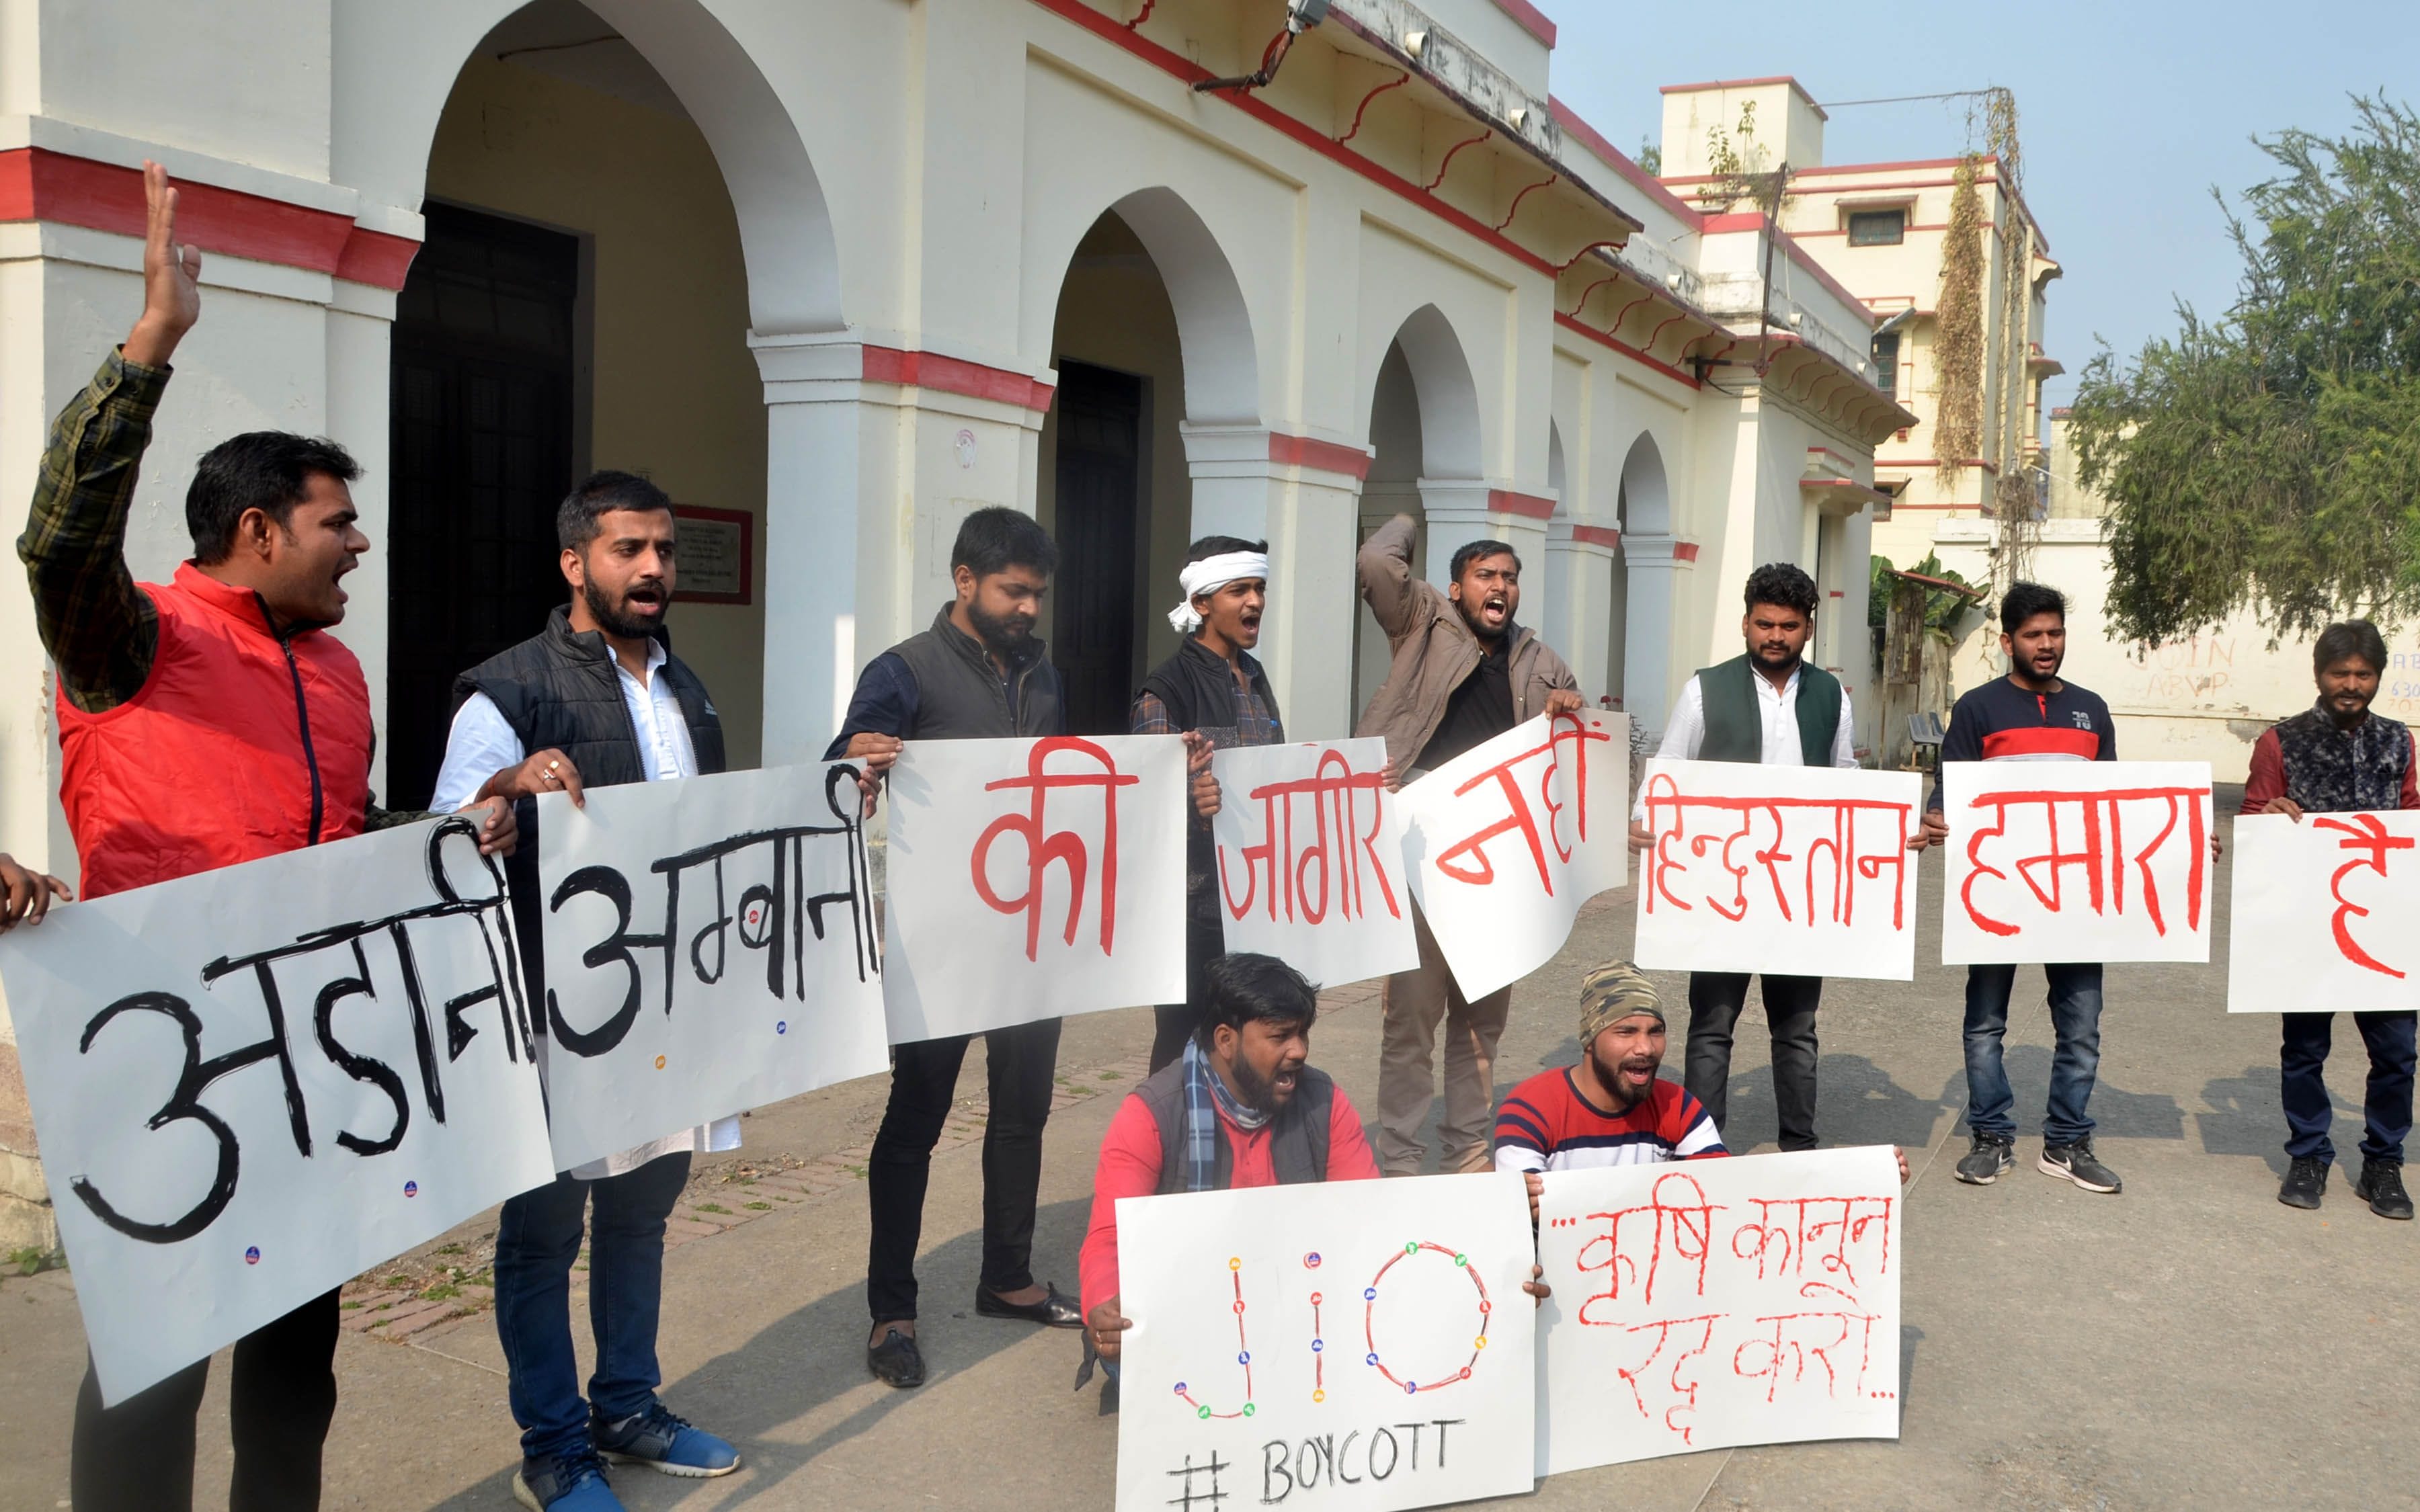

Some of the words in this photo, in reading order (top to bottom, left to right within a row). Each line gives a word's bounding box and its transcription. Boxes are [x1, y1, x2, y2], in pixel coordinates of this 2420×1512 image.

[547, 763, 879, 1057] अम्बानी
[970, 736, 1140, 962] की
[1217, 749, 1401, 925] जागीर
[1644, 773, 1912, 931] हिन्दुस्तान
[1960, 786, 2212, 937] हमारा
[2312, 813, 2415, 979] है
[70, 816, 536, 1245] अडानी
[1732, 1196, 1894, 1288] कानून
[1259, 1419, 1466, 1505] BOYCOTT
